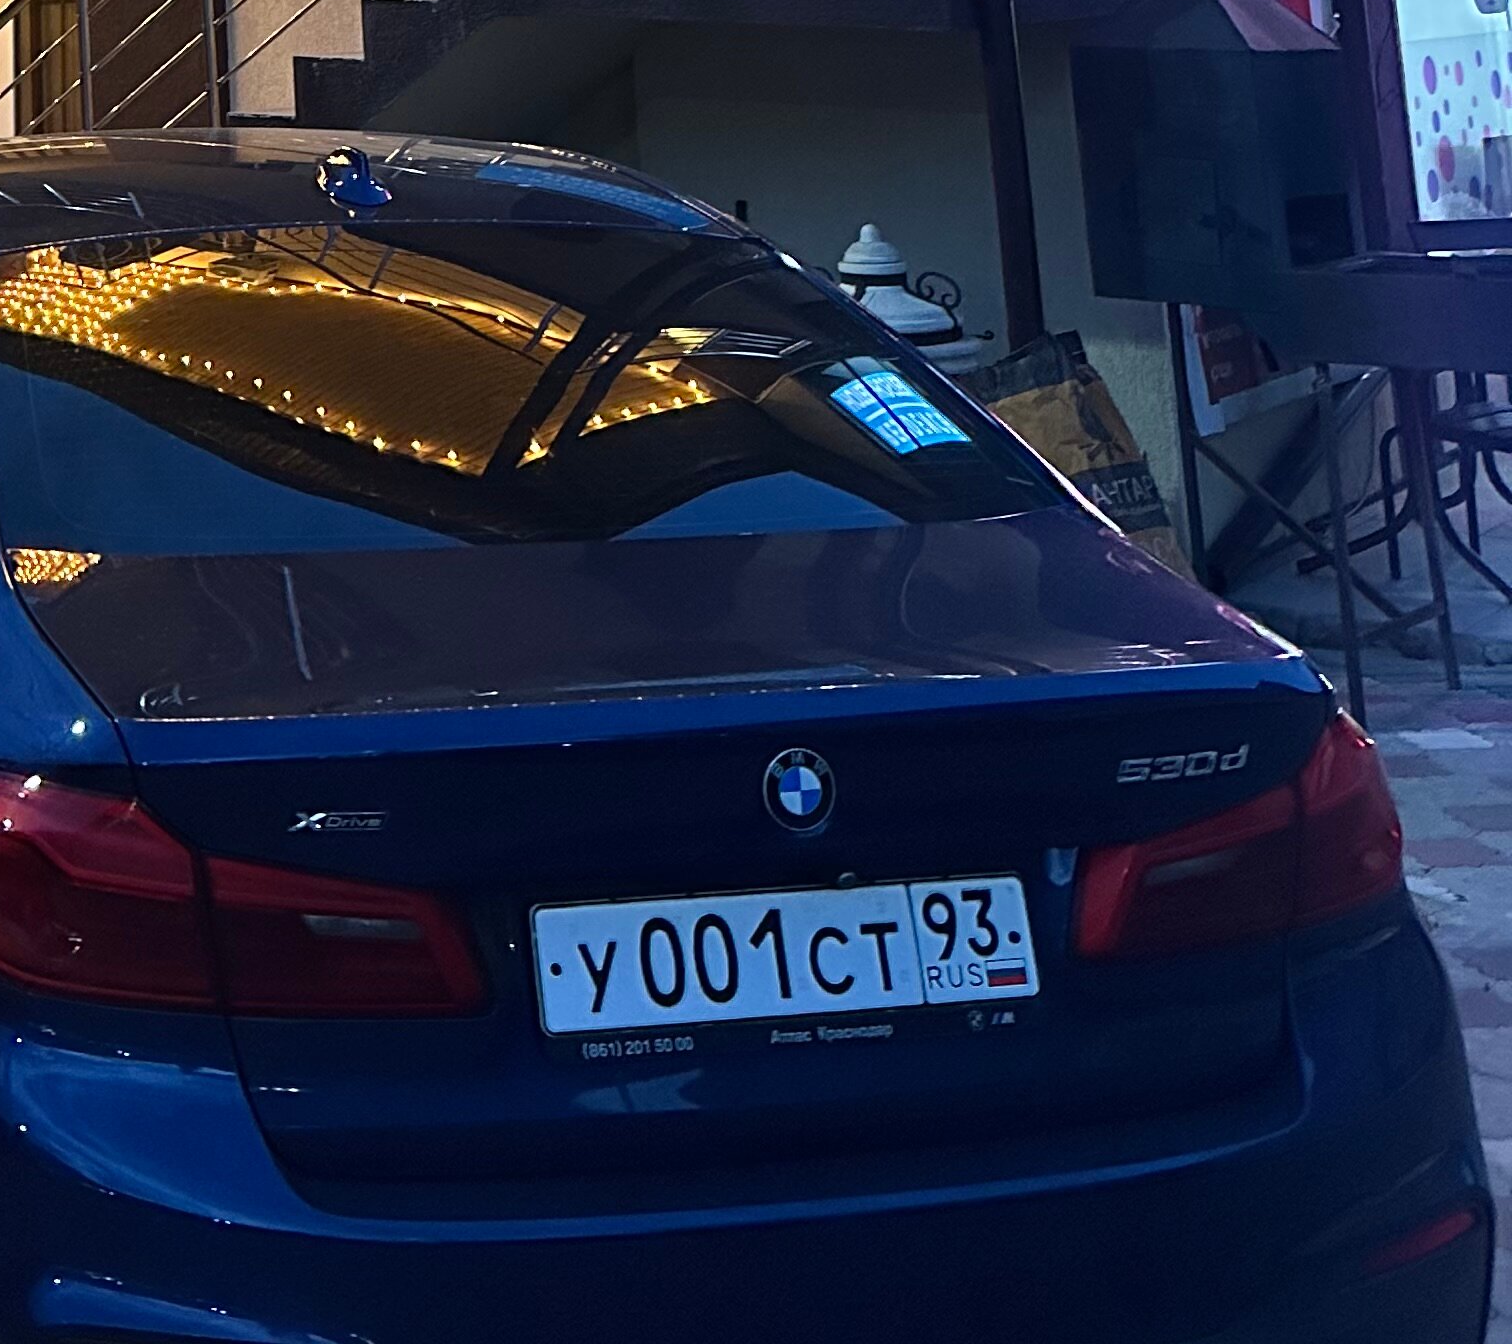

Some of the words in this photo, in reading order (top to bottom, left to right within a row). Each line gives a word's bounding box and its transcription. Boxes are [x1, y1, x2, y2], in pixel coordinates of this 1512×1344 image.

[1115, 743, 1251, 784] 530d
[921, 889, 1000, 962] 93
[926, 965, 985, 991] RUS
